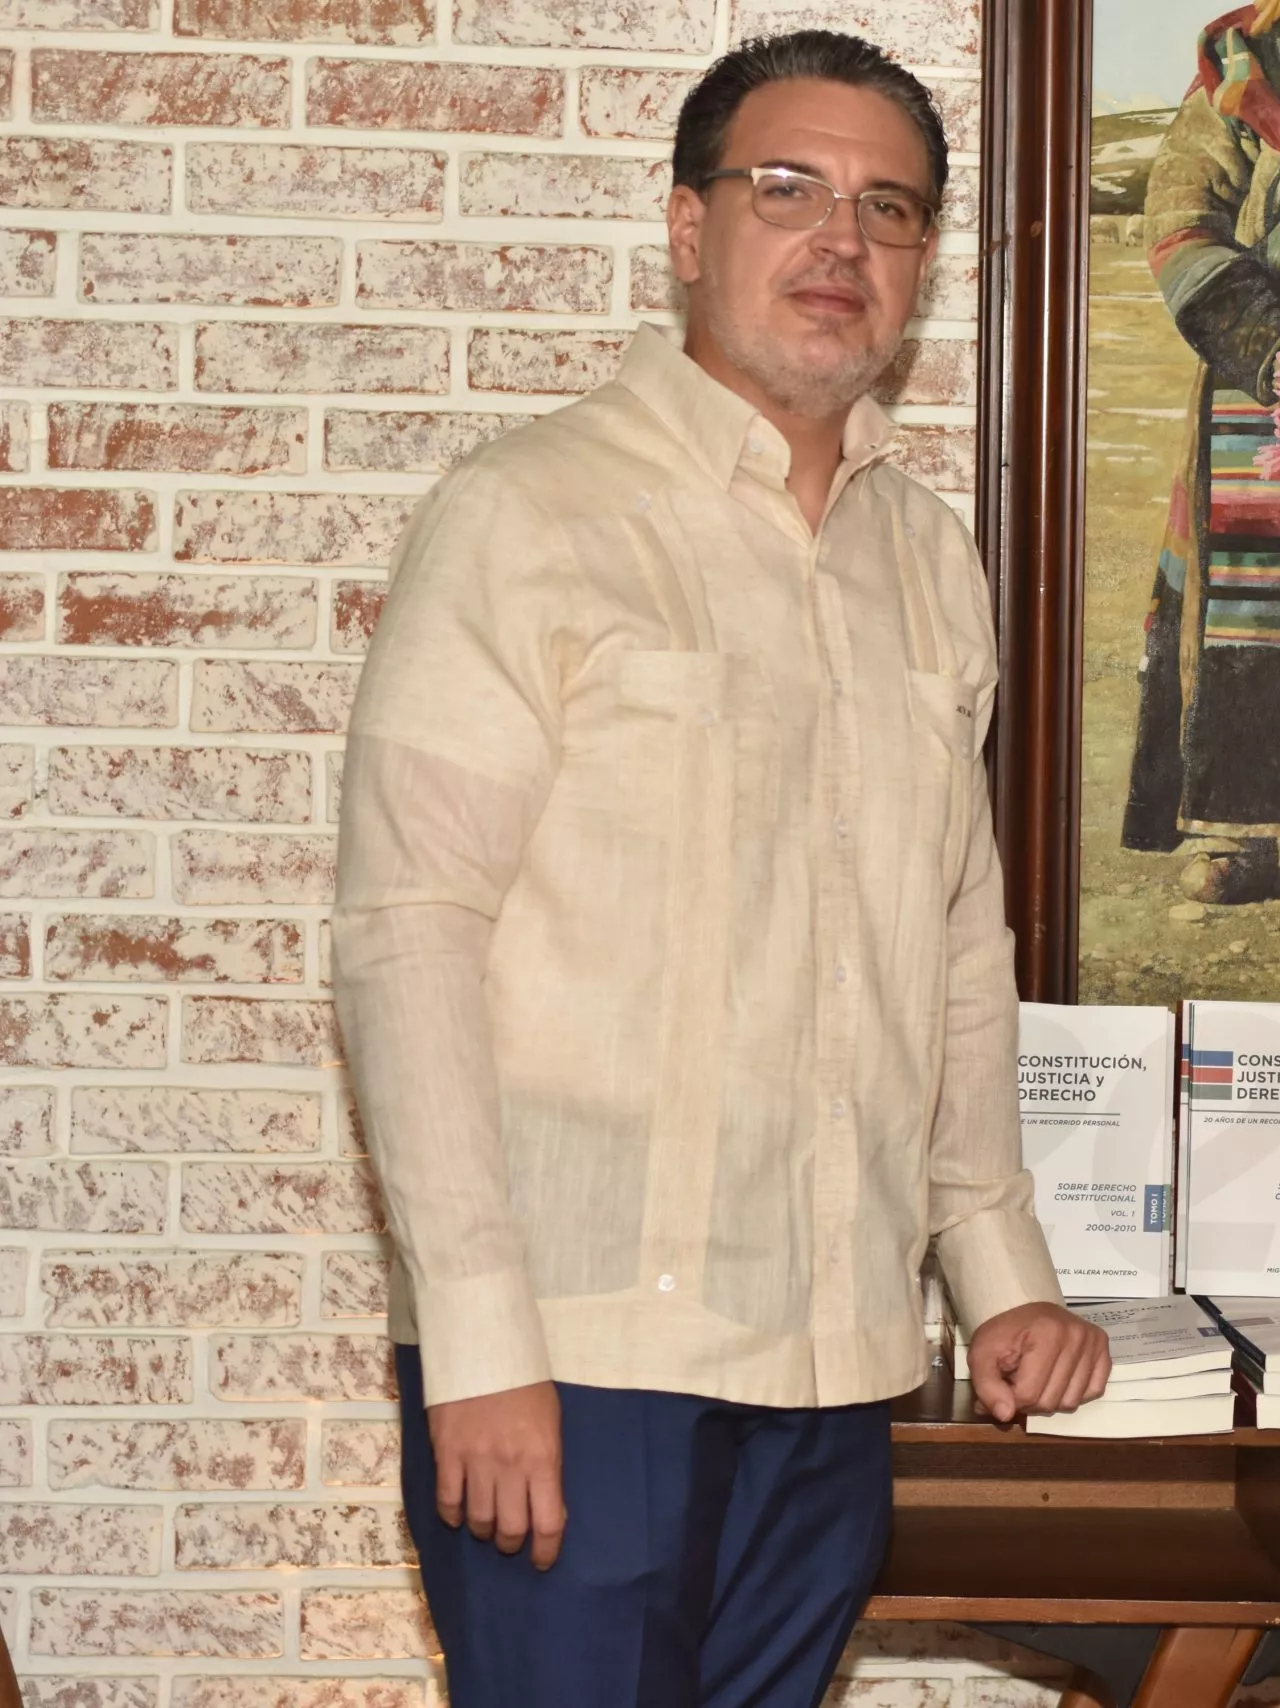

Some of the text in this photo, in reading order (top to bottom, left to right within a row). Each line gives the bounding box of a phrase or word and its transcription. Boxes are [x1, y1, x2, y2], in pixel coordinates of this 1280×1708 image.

[1018, 1055, 1147, 1071] CONSTITUCIÓN,
[1018, 1072, 1105, 1087] JUSTICIA y
[1018, 1089, 1096, 1102] DERECHO
[1215, 1116, 1235, 1124] AÑOS
[1057, 1183, 1137, 1192] SOBRE DERECHO
[1054, 1193, 1137, 1203] CONSTITUCIONAL
[1150, 1198, 1158, 1225] TOMO
[1085, 1224, 1137, 1232] 2000-2010
[1102, 1269, 1138, 1277] MONTERO
